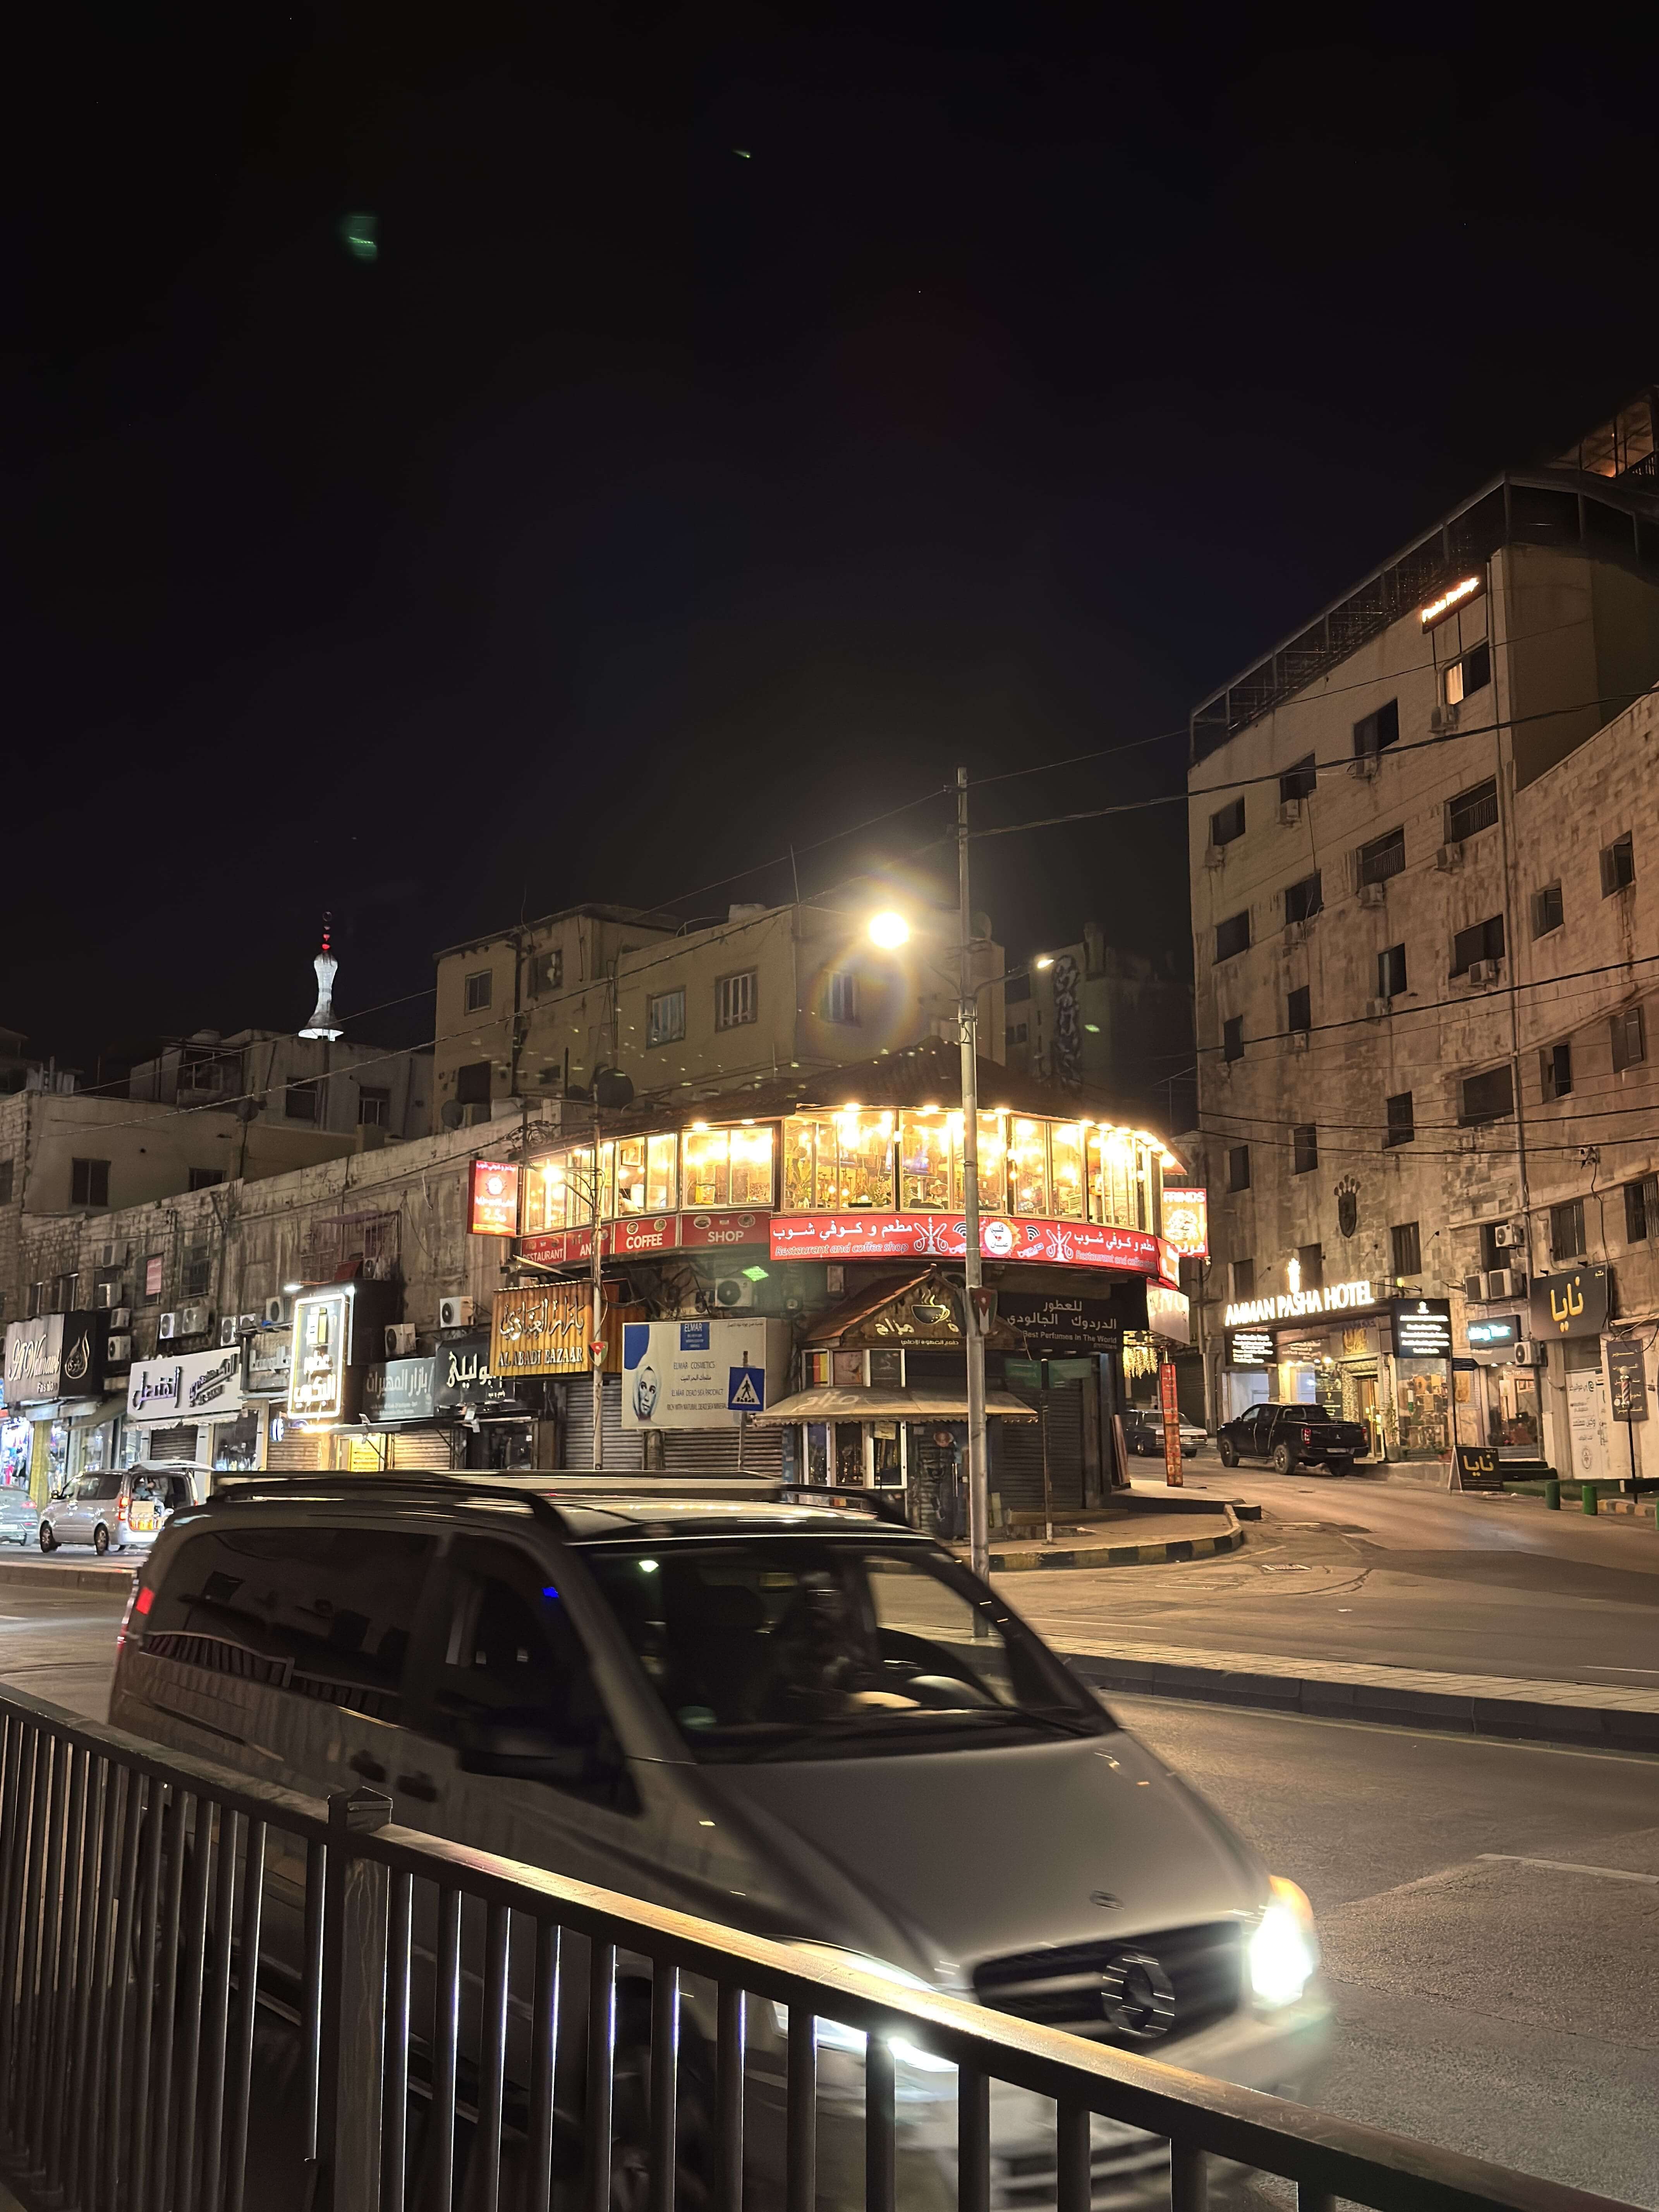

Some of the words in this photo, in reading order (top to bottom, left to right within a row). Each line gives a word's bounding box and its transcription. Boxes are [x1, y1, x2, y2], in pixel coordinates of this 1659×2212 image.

[708, 1231, 744, 1242] SHOP
[773, 1222, 815, 1240] شوب
[819, 1220, 863, 1240] كوفي
[867, 1224, 877, 1237] و
[881, 1219, 912, 1238] مطعم
[626, 1233, 663, 1249] COFFEE
[1074, 1231, 1104, 1245] شوب
[1106, 1232, 1131, 1250] كوفي
[1140, 1238, 1155, 1254] مطعم
[580, 1242, 595, 1257] AN
[776, 1245, 829, 1256] Restaurant
[830, 1242, 850, 1253] and
[853, 1241, 881, 1252] coffee
[883, 1241, 908, 1253] shop
[1043, 1300, 1082, 1312] للعطور
[1225, 1297, 1275, 1326] AMMAN
[1277, 1290, 1322, 1318] PASHA
[1324, 1280, 1375, 1310] HOTEL
[1551, 1276, 1583, 1332] نايا
[549, 1296, 584, 1336] بازار
[685, 1323, 702, 1332] ELMAR
[1041, 1331, 1073, 1340] Perfumes
[498, 1352, 511, 1366] AL
[512, 1350, 542, 1366] ABADI
[544, 1346, 583, 1364] BAZAAR
[1463, 1454, 1494, 1476] نايا
